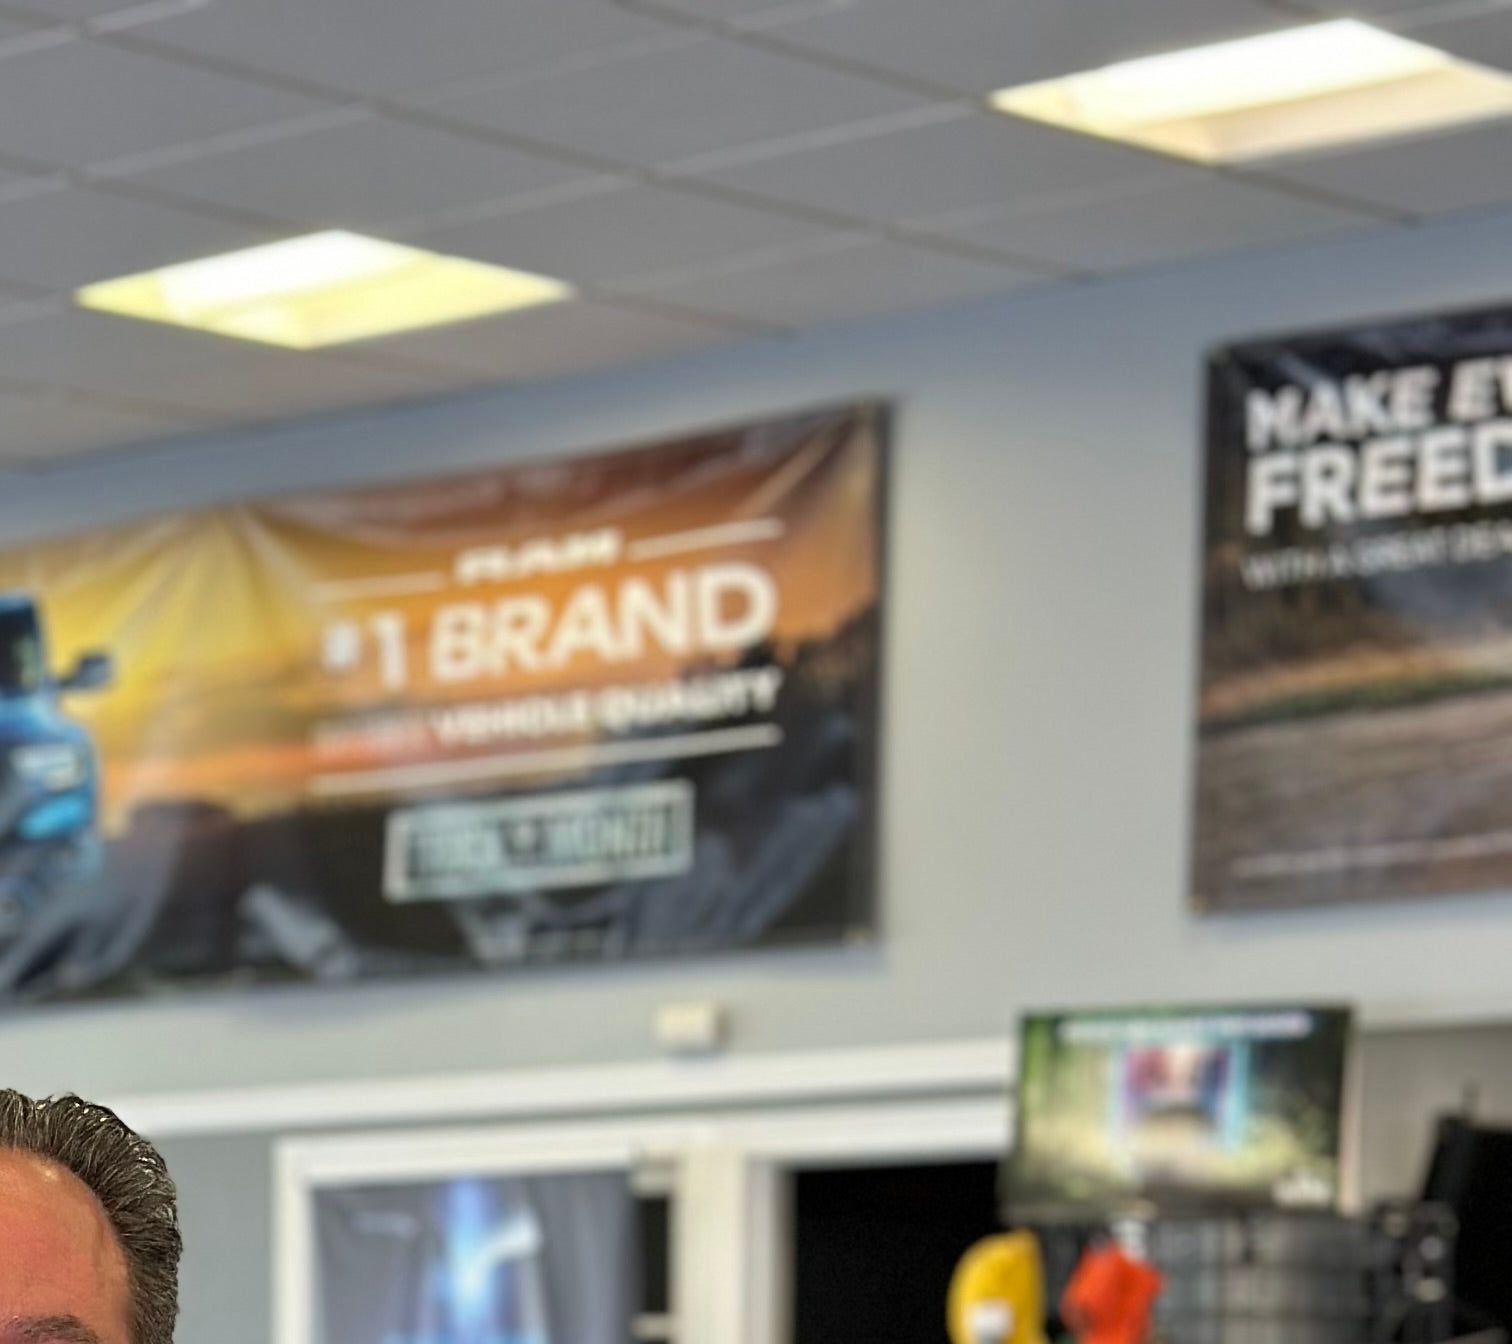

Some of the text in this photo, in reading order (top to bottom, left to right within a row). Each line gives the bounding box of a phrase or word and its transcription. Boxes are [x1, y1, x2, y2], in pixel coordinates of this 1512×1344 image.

[1245, 364, 1439, 453] MAKE
[428, 560, 778, 682] BRAND
[601, 668, 781, 731] QUALITY
